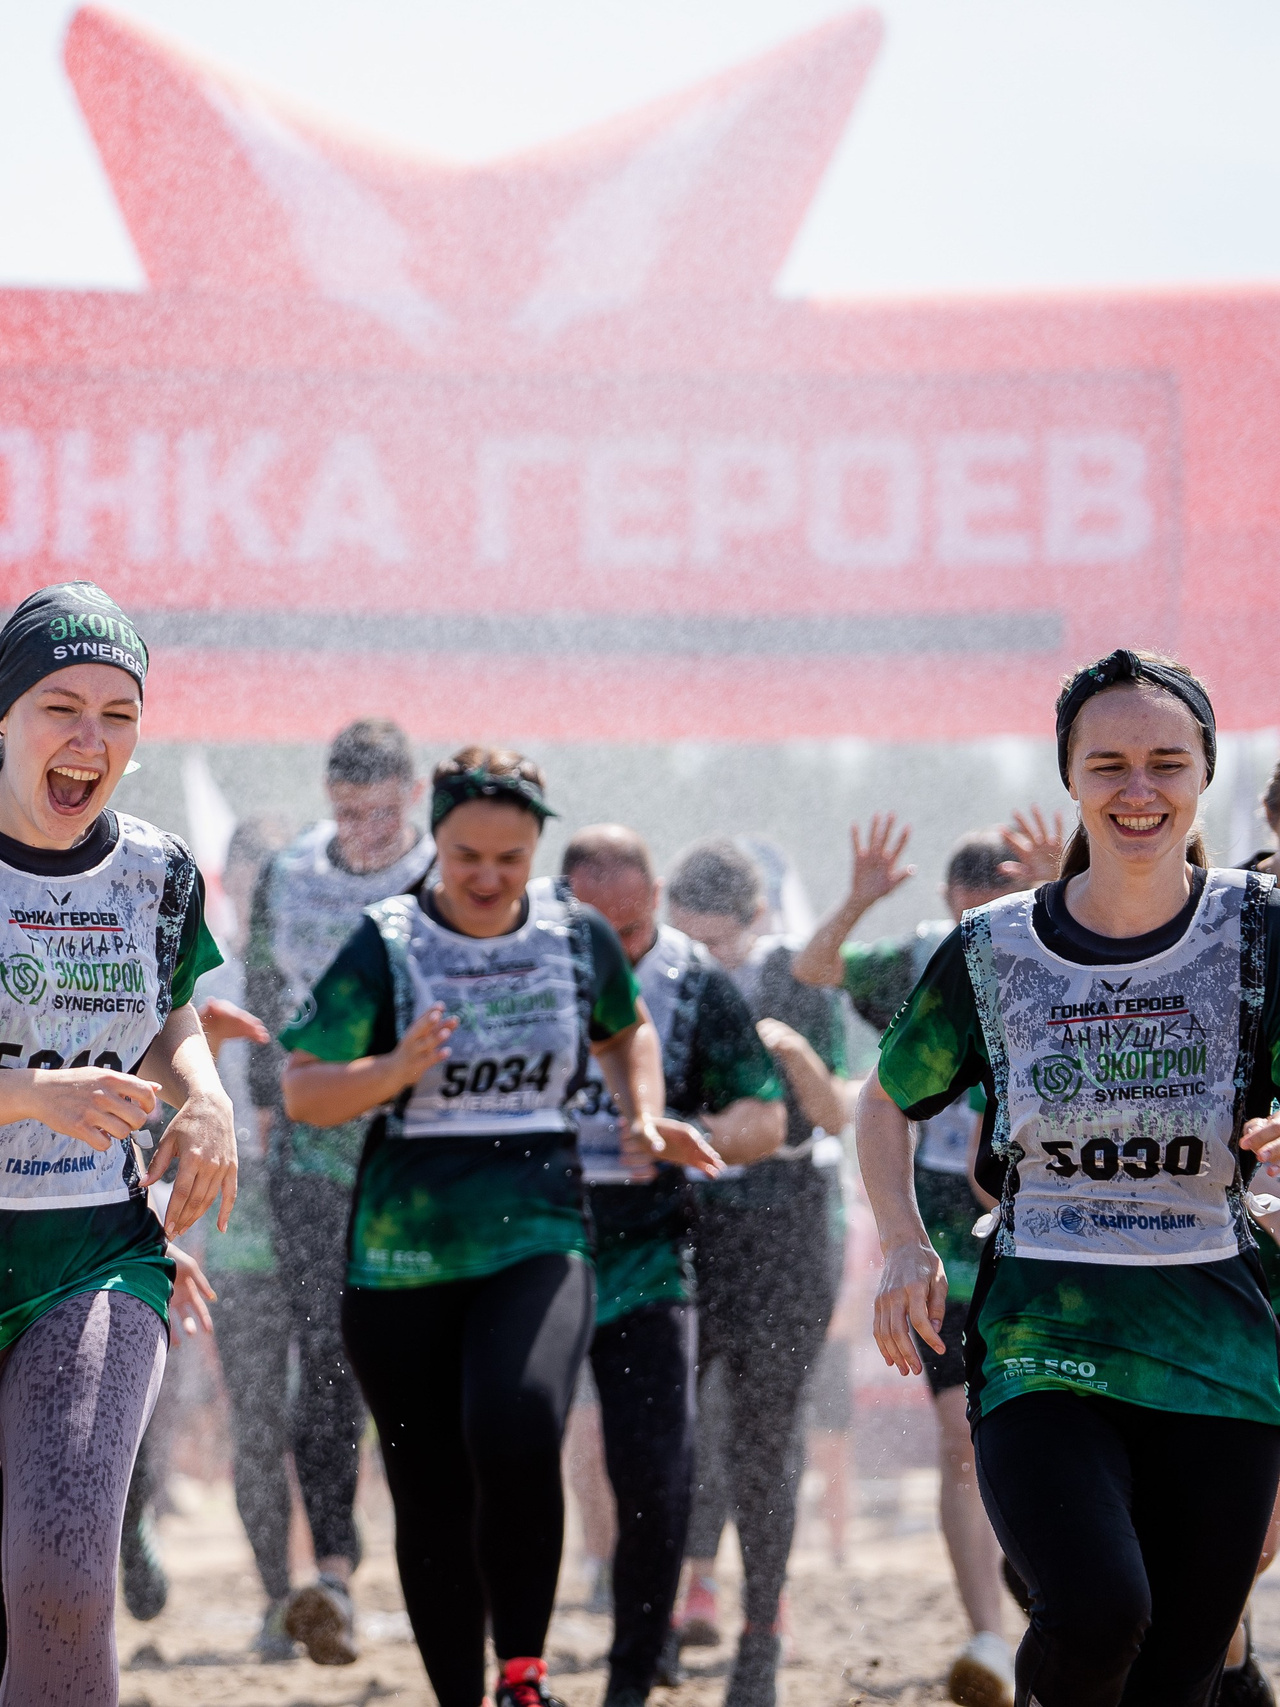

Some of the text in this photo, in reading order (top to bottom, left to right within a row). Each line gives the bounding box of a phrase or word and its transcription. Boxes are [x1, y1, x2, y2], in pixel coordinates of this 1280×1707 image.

[472, 434, 1154, 567] ГЕРОЕВ
[49, 613, 147, 666] ЭКОГЕР
[53, 642, 145, 679] SYNERGE
[60, 911, 119, 926] ГЕРОЕВ
[55, 960, 146, 993] ЭКОГЕРОЙ
[54, 995, 145, 1013] SYNERGETIC
[1051, 995, 1185, 1019] ГОНКА ГЕРОЕВ
[1062, 1014, 1214, 1049] АННУШКА
[441, 1053, 553, 1098] 5034
[1096, 1040, 1207, 1083] ЭКОГЕРОЙ
[1095, 1081, 1206, 1102] SYNERGETIC
[1091, 1213, 1196, 1230] ГАЗПРОМБАНК
[1003, 1357, 1096, 1378] BE ECO
